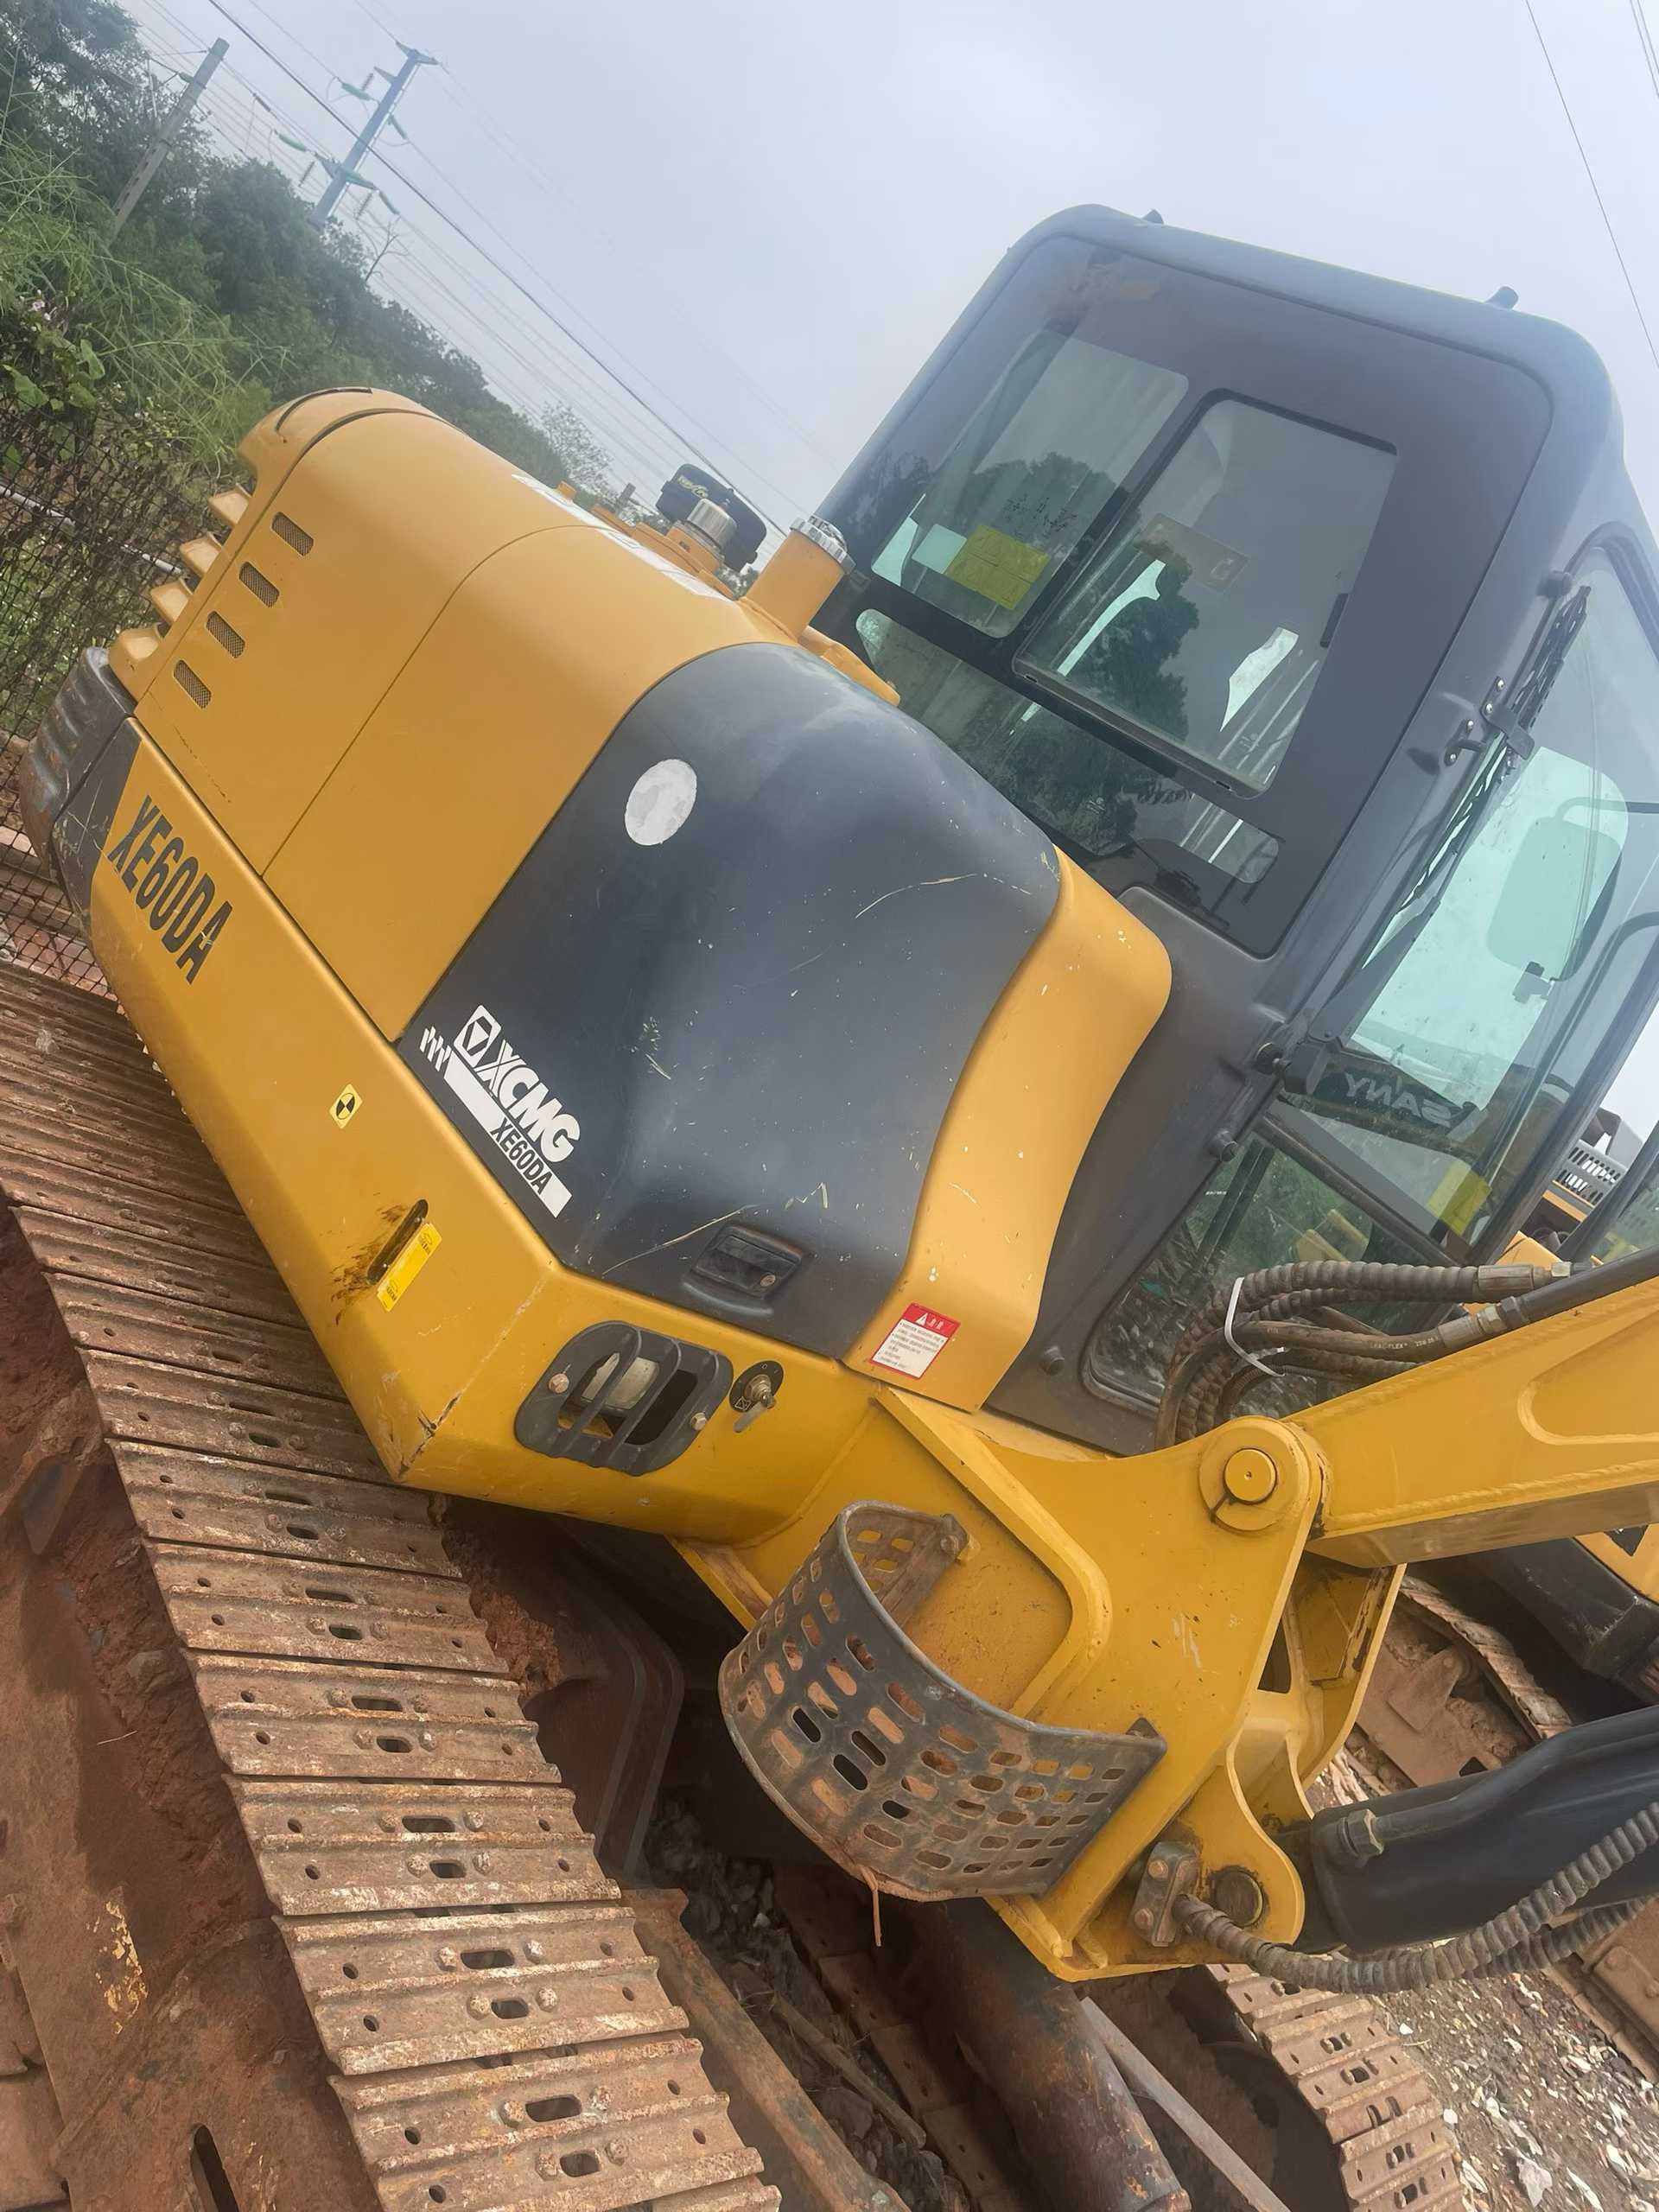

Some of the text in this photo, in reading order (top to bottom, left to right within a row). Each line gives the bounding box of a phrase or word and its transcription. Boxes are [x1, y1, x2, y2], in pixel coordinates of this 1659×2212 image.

[107, 794, 232, 985] XE60DA
[474, 1039, 581, 1163] XCMG
[490, 1117, 553, 1195] XE60DA
